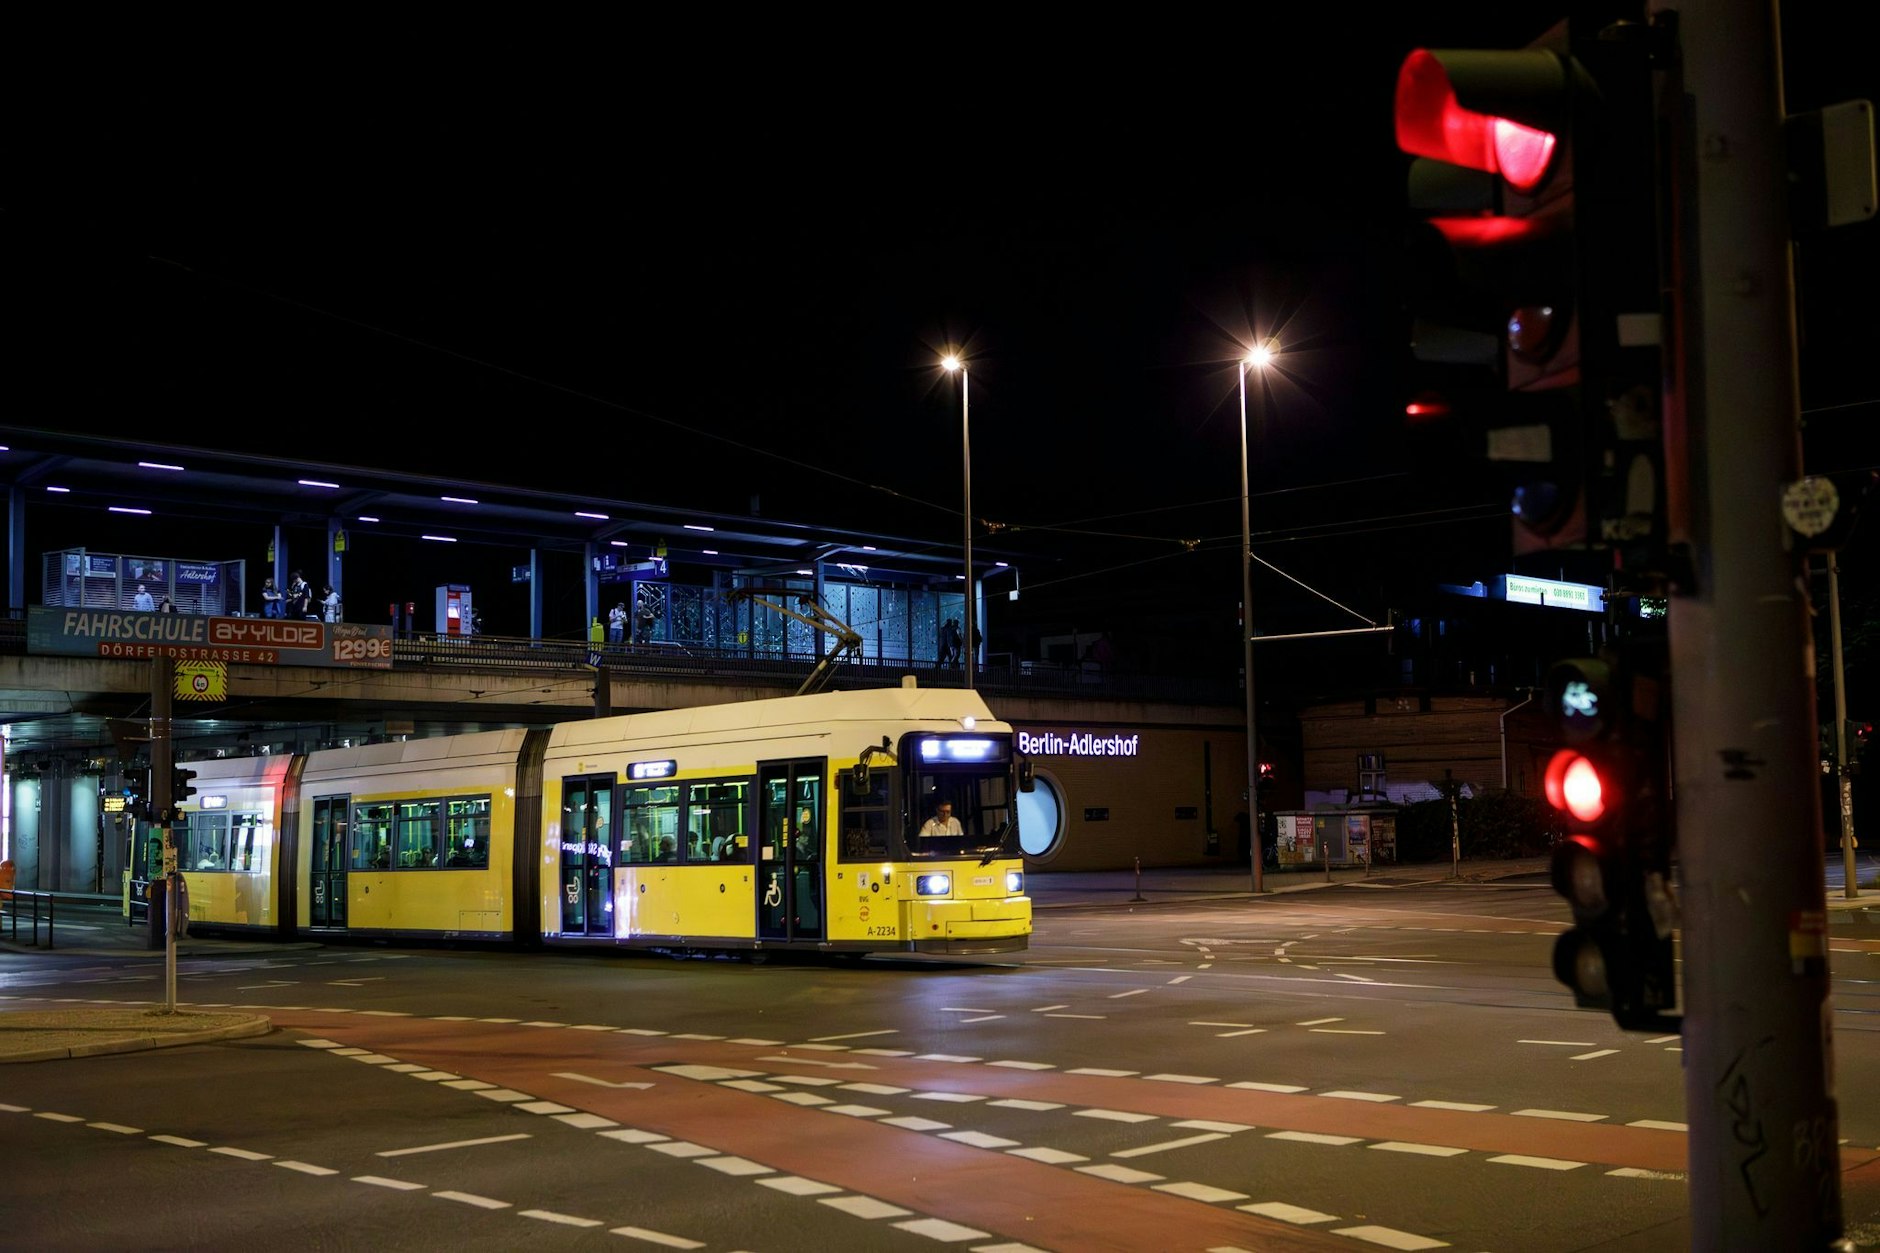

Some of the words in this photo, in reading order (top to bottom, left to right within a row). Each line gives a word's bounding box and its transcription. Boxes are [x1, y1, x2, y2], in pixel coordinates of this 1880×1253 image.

[660, 560, 667, 573] 4
[63, 611, 205, 641] FAHRSCHULE
[251, 625, 317, 643] YILDIZ
[101, 643, 250, 661] DÖRFELDSTRASSE
[257, 651, 274, 662] 42
[333, 638, 390, 660] 1299€
[590, 652, 601, 666] W
[1018, 731, 1138, 756] Berlin-Adlershof
[867, 926, 896, 936] A-2234
